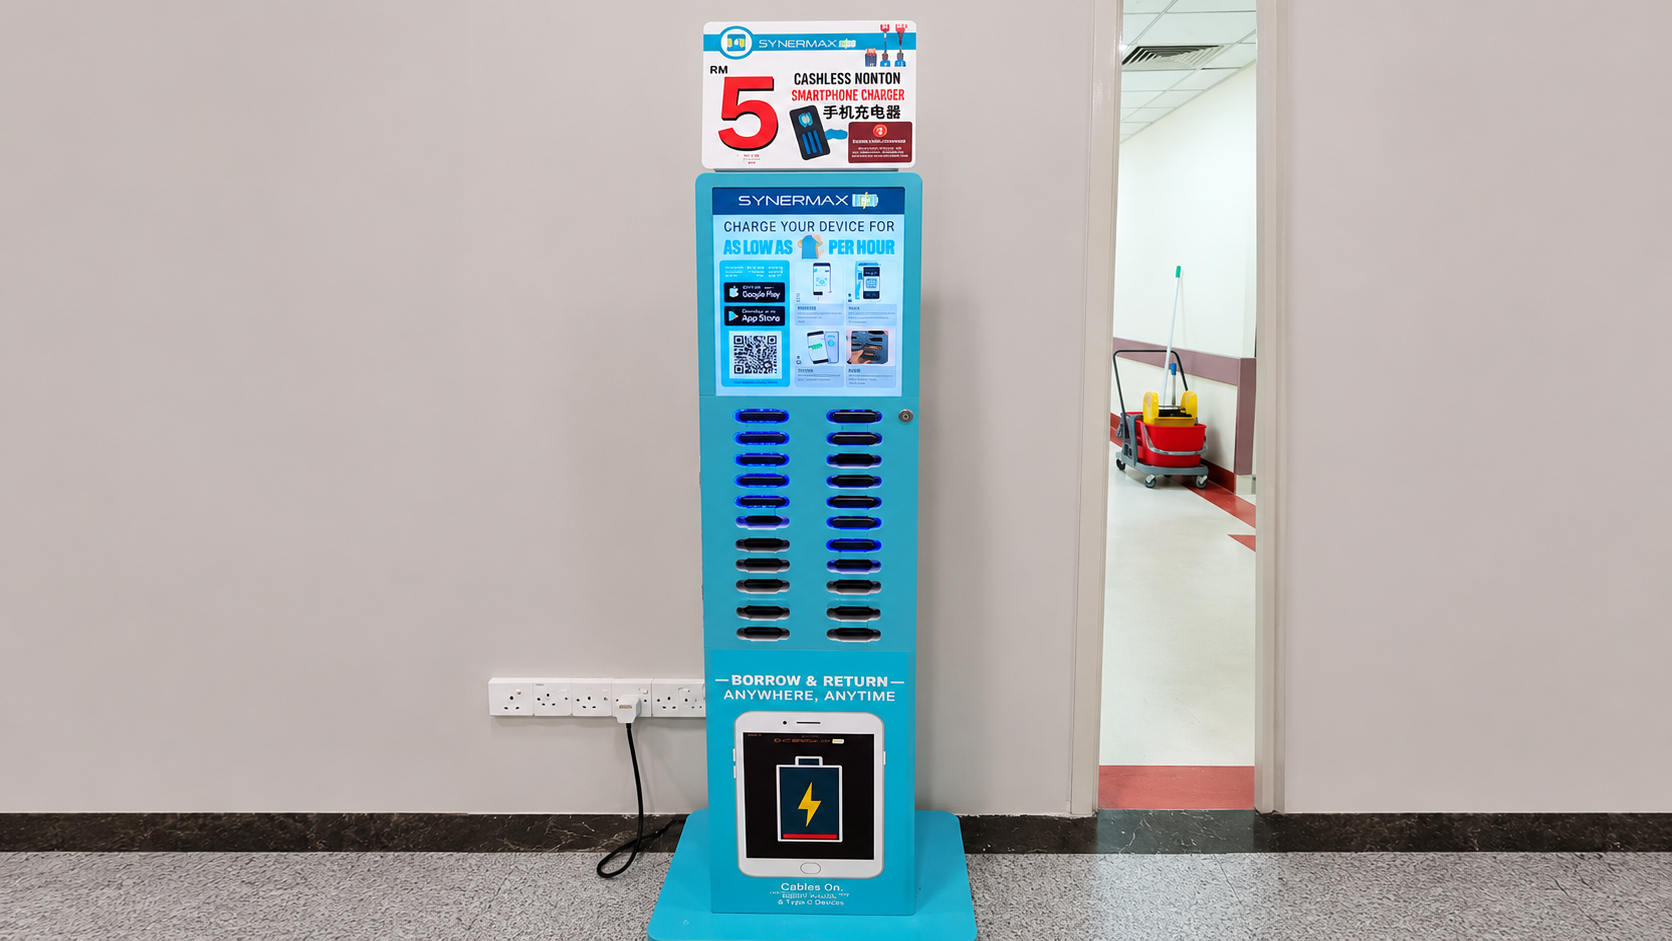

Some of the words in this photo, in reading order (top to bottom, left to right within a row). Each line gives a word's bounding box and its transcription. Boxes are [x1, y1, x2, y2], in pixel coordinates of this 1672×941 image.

[759, 40, 837, 48] SYNERMAX
[710, 66, 728, 74] RM
[794, 73, 851, 85] CASHLESS
[855, 72, 900, 84] NONTON
[792, 90, 858, 102] SMARTPHONE
[862, 89, 904, 101] CHARGER
[718, 76, 778, 151] 5
[823, 105, 901, 120] 手机充电器
[738, 196, 848, 206] SYNERMAX
[724, 222, 776, 232] CHARGE
[781, 222, 815, 232] YOUR
[820, 221, 865, 232] DEVICE
[870, 221, 894, 232] FOR
[723, 240, 741, 255] AS
[743, 240, 774, 255] LOW
[774, 240, 793, 255] AS
[828, 240, 855, 255] PER
[858, 240, 895, 255] HOUR
[732, 674, 801, 686] BORROW
[806, 676, 817, 686] &
[823, 676, 888, 687] RETURN
[724, 690, 818, 702] ANYWHERE,
[824, 691, 895, 702] ANYTIME
[781, 882, 820, 891] Cables
